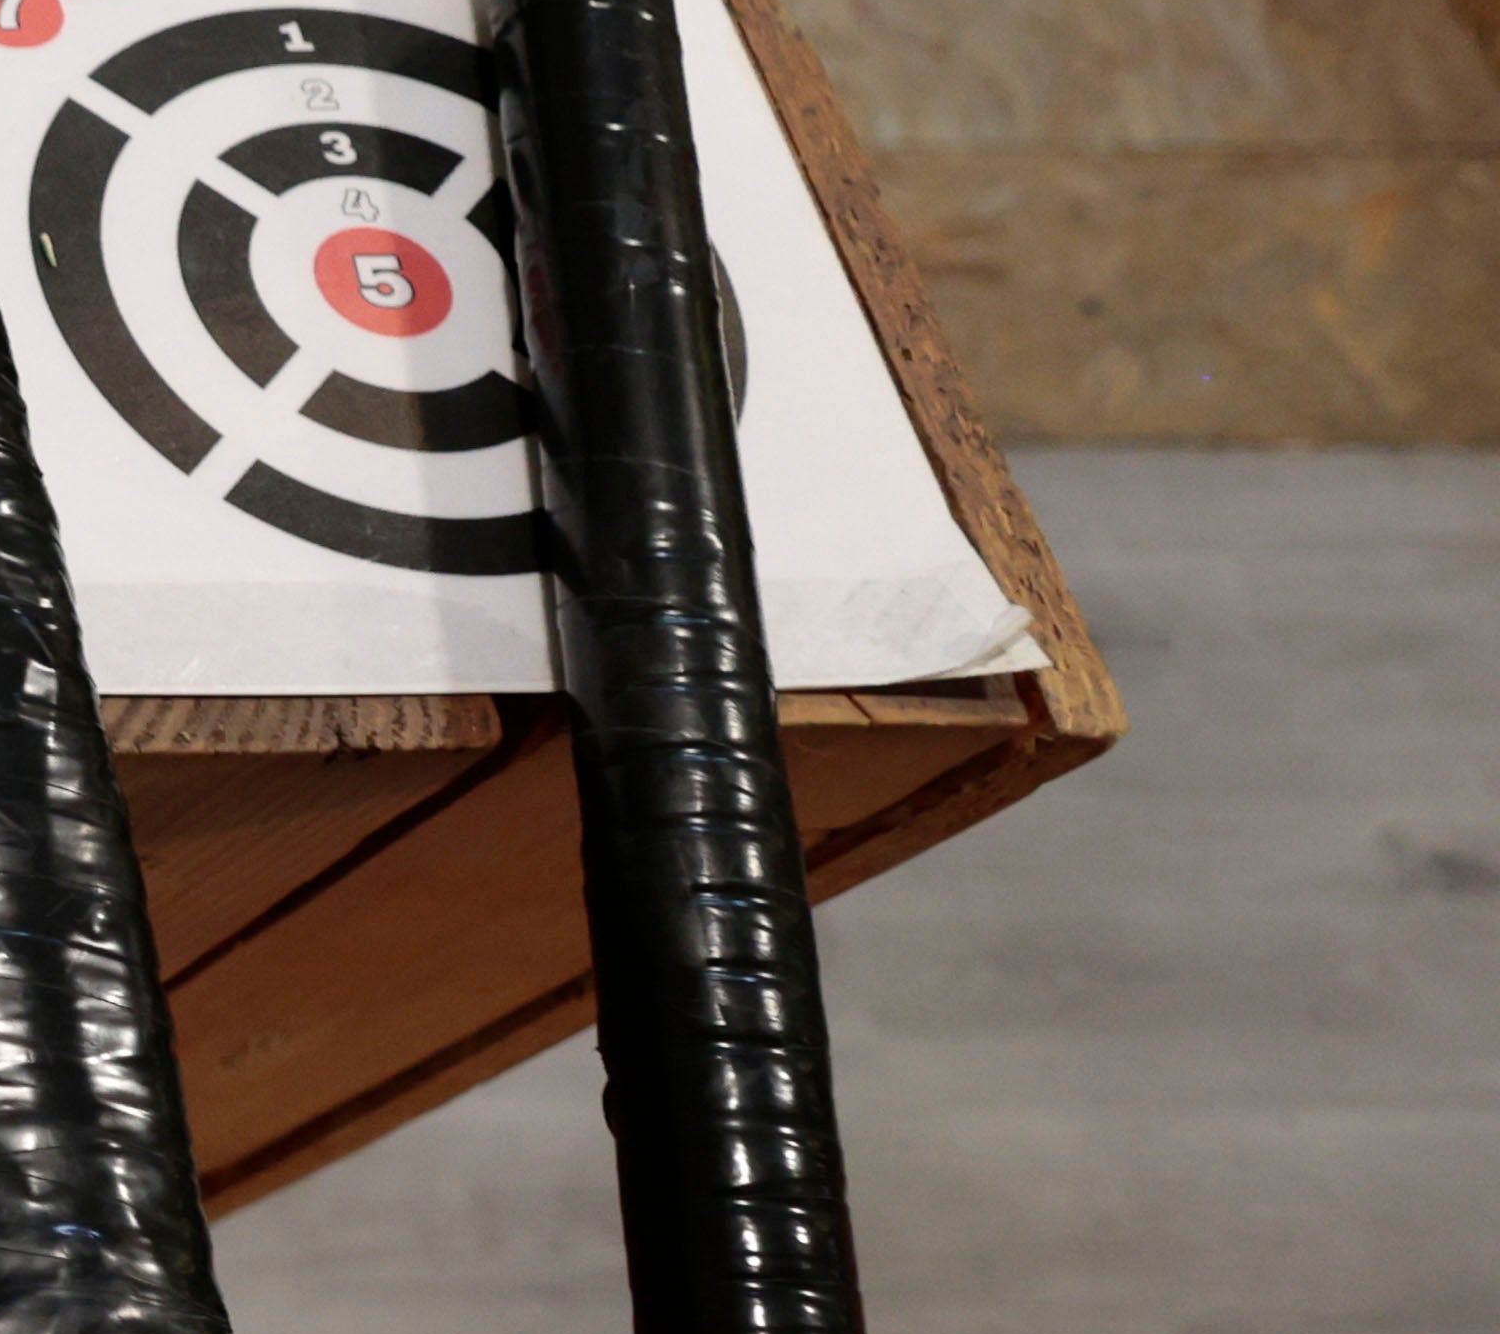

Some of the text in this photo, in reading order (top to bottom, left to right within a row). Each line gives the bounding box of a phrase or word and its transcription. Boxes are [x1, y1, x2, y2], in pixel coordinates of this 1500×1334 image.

[278, 21, 315, 52] 1
[300, 78, 340, 111] 2
[319, 130, 357, 165] 3
[341, 187, 379, 222] 4
[352, 253, 415, 309] 5
